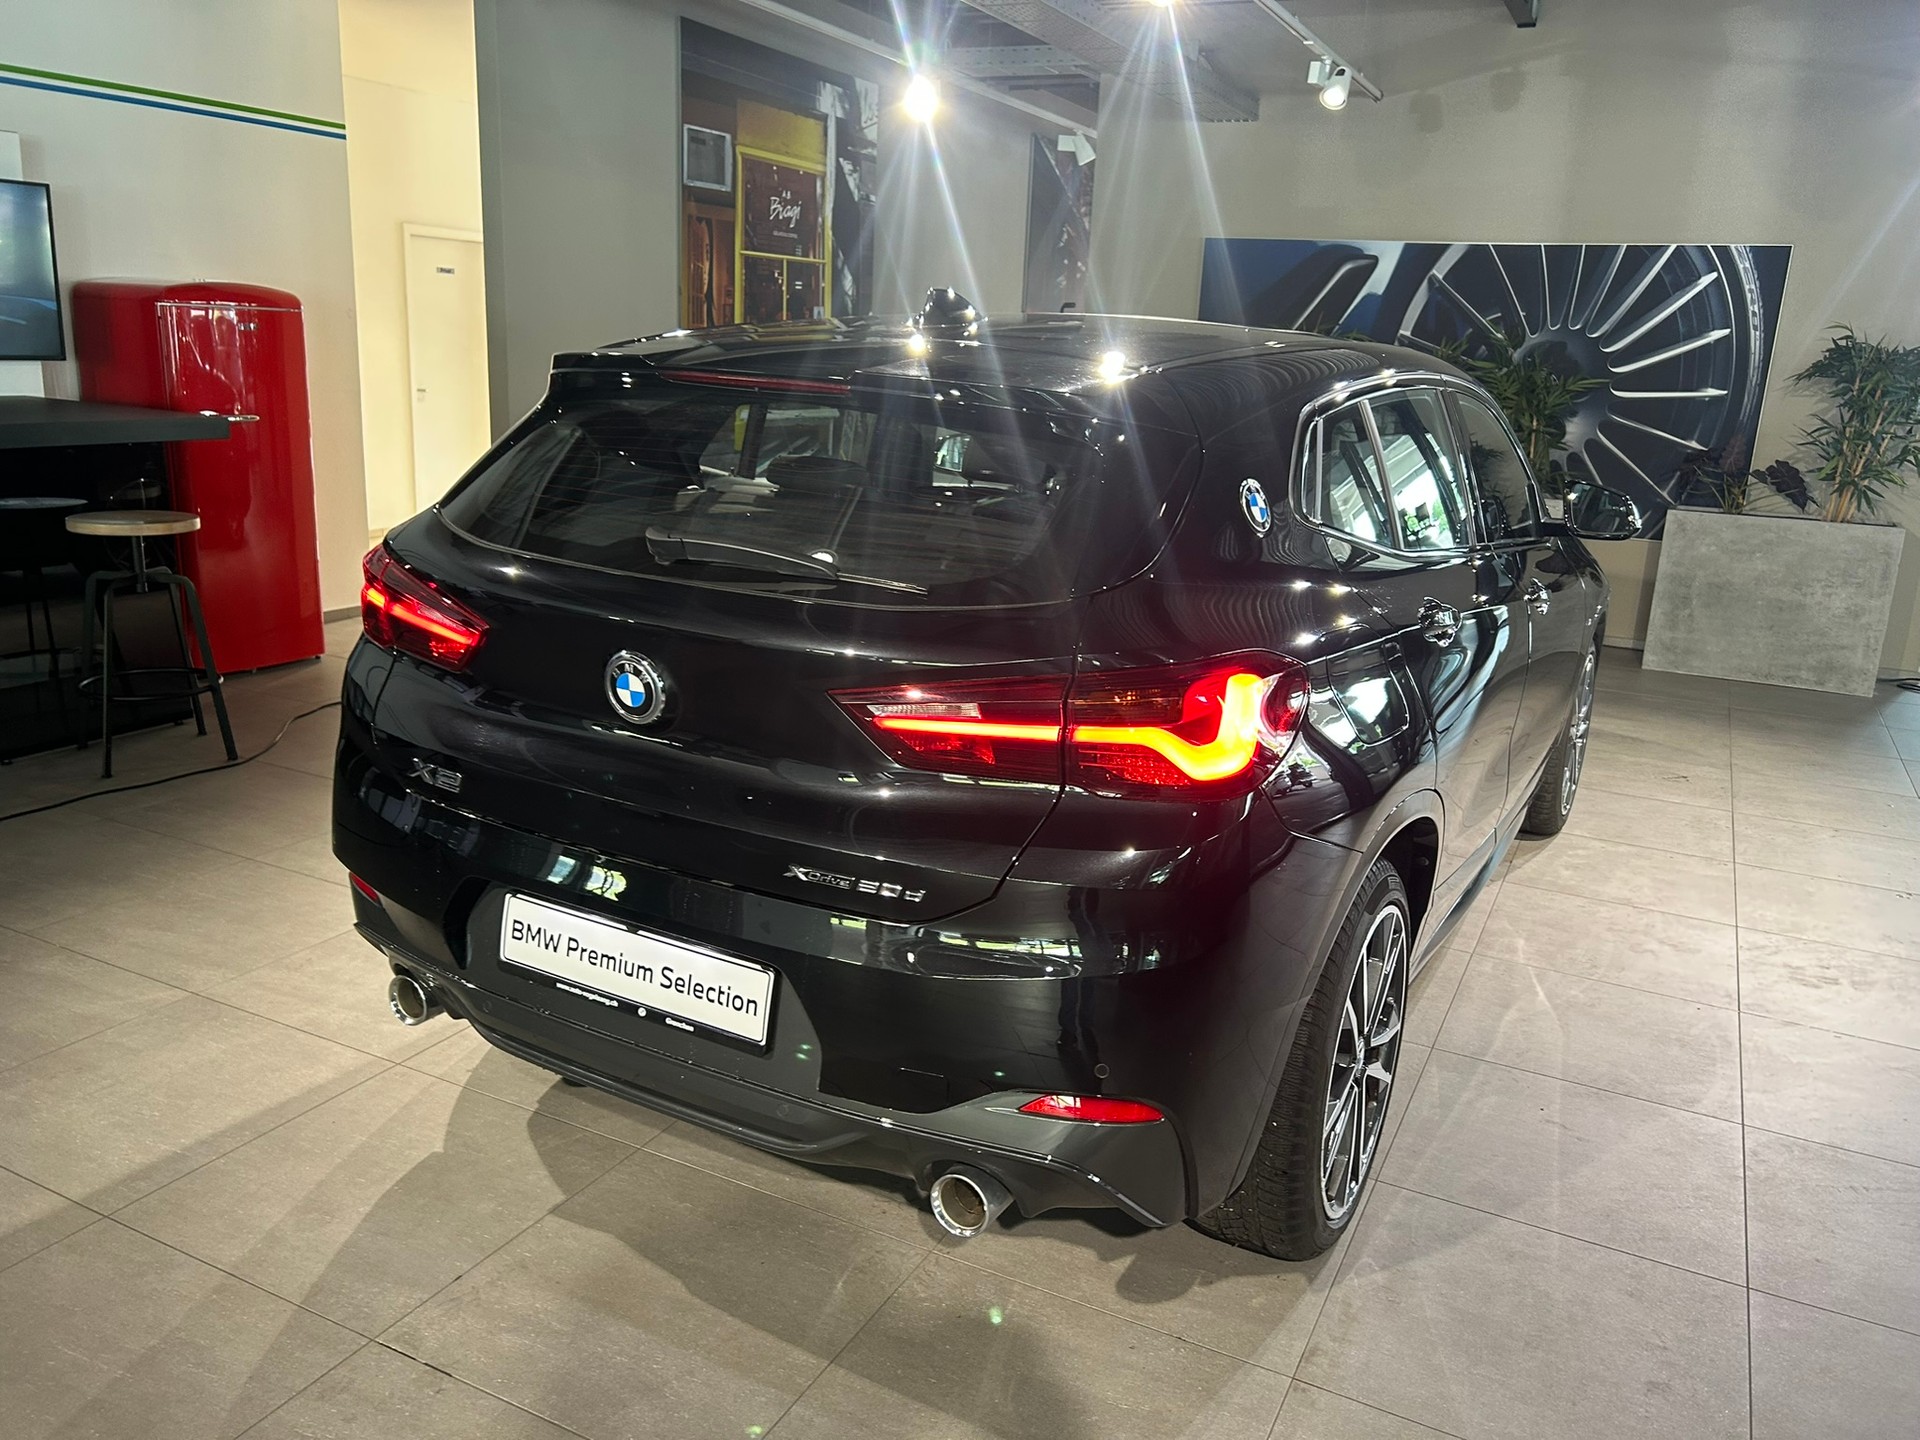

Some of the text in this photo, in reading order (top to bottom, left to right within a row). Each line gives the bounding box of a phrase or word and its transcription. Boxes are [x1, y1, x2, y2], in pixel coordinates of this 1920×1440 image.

[769, 196, 802, 228] Biagi
[407, 758, 462, 793] X2
[511, 919, 561, 953] BMW
[566, 937, 653, 984] Premium
[660, 966, 758, 1016] Selection
